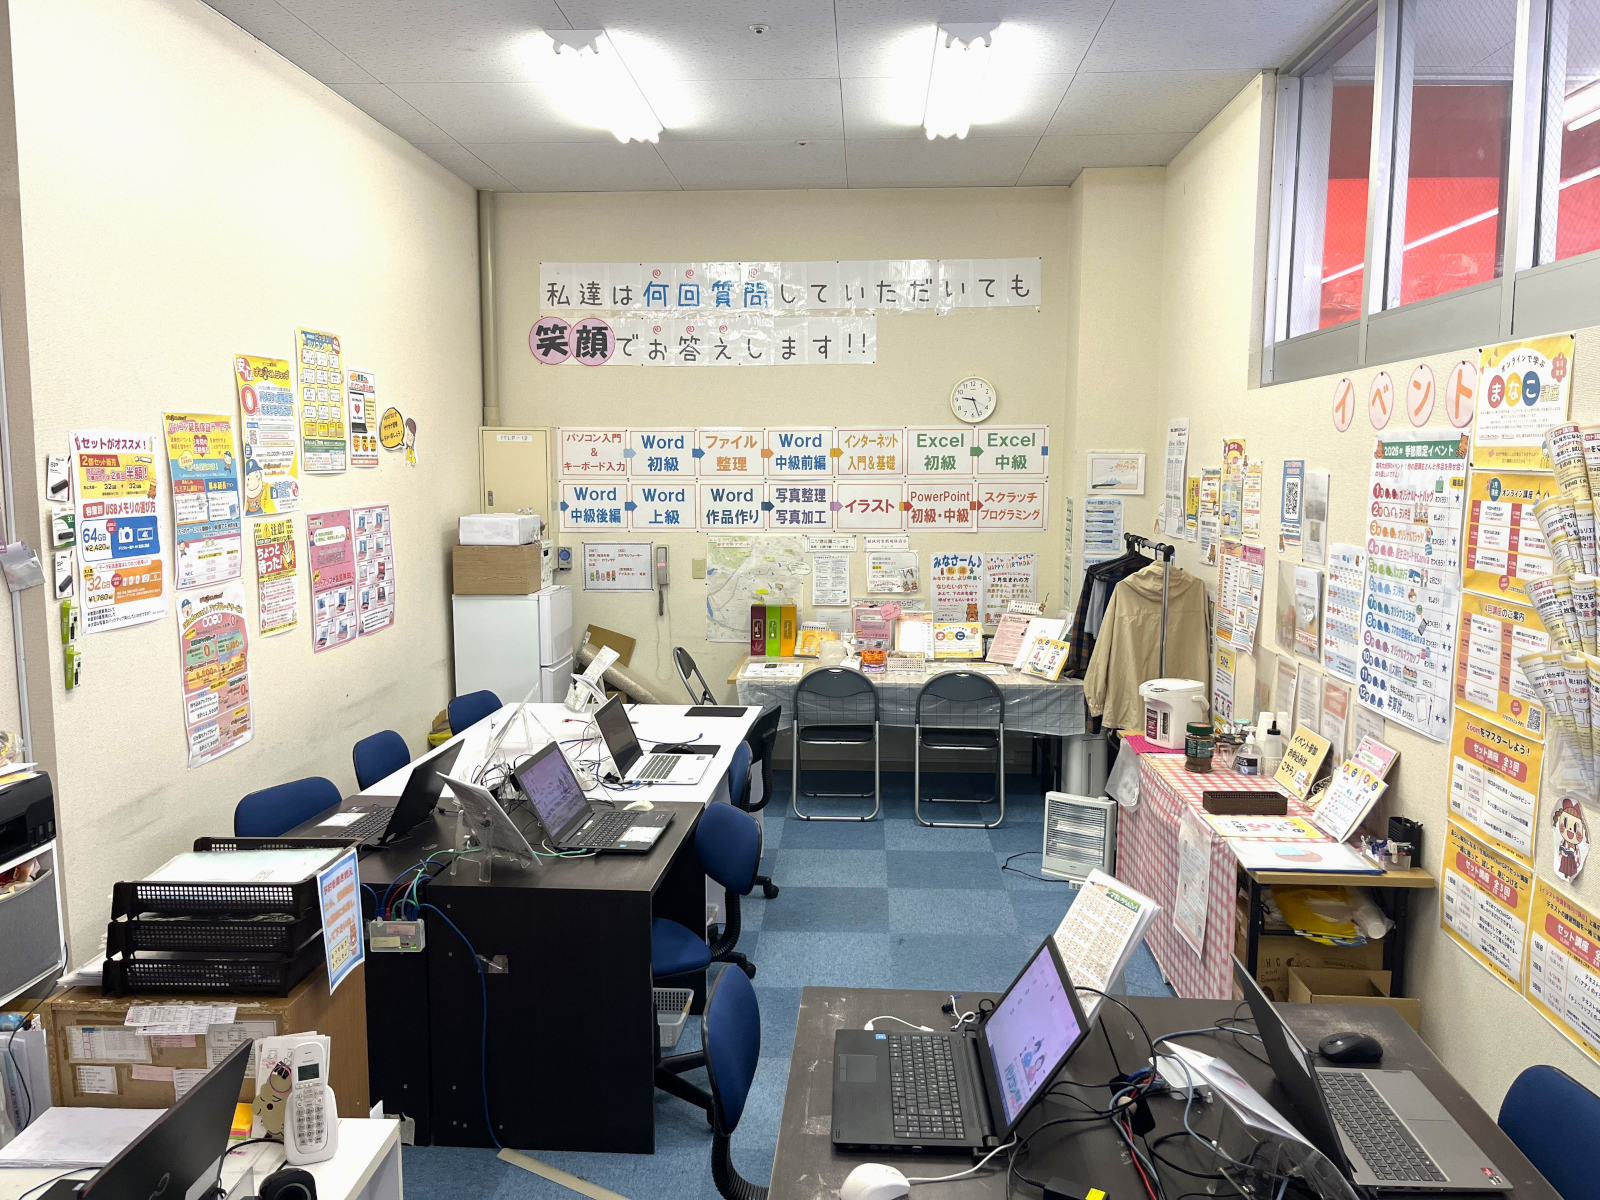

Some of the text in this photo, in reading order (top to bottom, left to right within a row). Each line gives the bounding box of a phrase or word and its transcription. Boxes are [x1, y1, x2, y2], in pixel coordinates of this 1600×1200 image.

[547, 274, 1030, 308] 私達は何回質問していただいても
[1501, 355, 1546, 373] オンラインで学ぶ
[1335, 369, 1473, 425] イベント
[566, 433, 621, 443] パソコン入門
[641, 435, 684, 449] Word
[705, 435, 757, 449] ファイル
[779, 434, 822, 448] Word
[844, 433, 898, 448] インターネット
[916, 433, 964, 448] Excel
[987, 432, 1035, 447] Excel
[590, 448, 598, 456] &
[1384, 445, 1454, 458] 2026年 季節限定イベント
[563, 462, 625, 472] キーボード入力
[647, 456, 679, 471] 初級
[716, 456, 747, 471] 整理
[775, 456, 826, 470] 中級前編
[924, 455, 956, 471] 初級
[995, 455, 1027, 470] 中級
[574, 487, 617, 501] Word
[642, 488, 685, 502] Word
[710, 488, 753, 502] Word
[775, 487, 826, 502] 写真整理
[911, 491, 970, 502] PowerPoint
[984, 491, 1037, 503] スクラッチ
[1501, 489, 1534, 500] オンライン講座
[844, 498, 894, 514] イラスト
[571, 508, 621, 523] 中級後編
[648, 509, 680, 524] 上級
[705, 509, 759, 525] 作品作り
[775, 509, 826, 525] 写真加工
[911, 508, 969, 523] 初級・中級
[980, 509, 1040, 521] プログラミング
[257, 543, 280, 560] ちょっと
[258, 555, 283, 575] 待った!
[987, 560, 1034, 572] HAPPY BIRTHDAY
[1484, 604, 1525, 623] 4月講座のご案内
[1387, 696, 1402, 716] 年賀状
[1294, 735, 1319, 757] イベント参加
[1466, 721, 1530, 757] Zoomをマスターしよう！
[1473, 742, 1520, 774] セット講座 全3回
[1465, 859, 1511, 898] セット講座 全3回
[1557, 923, 1590, 955] セット講座
